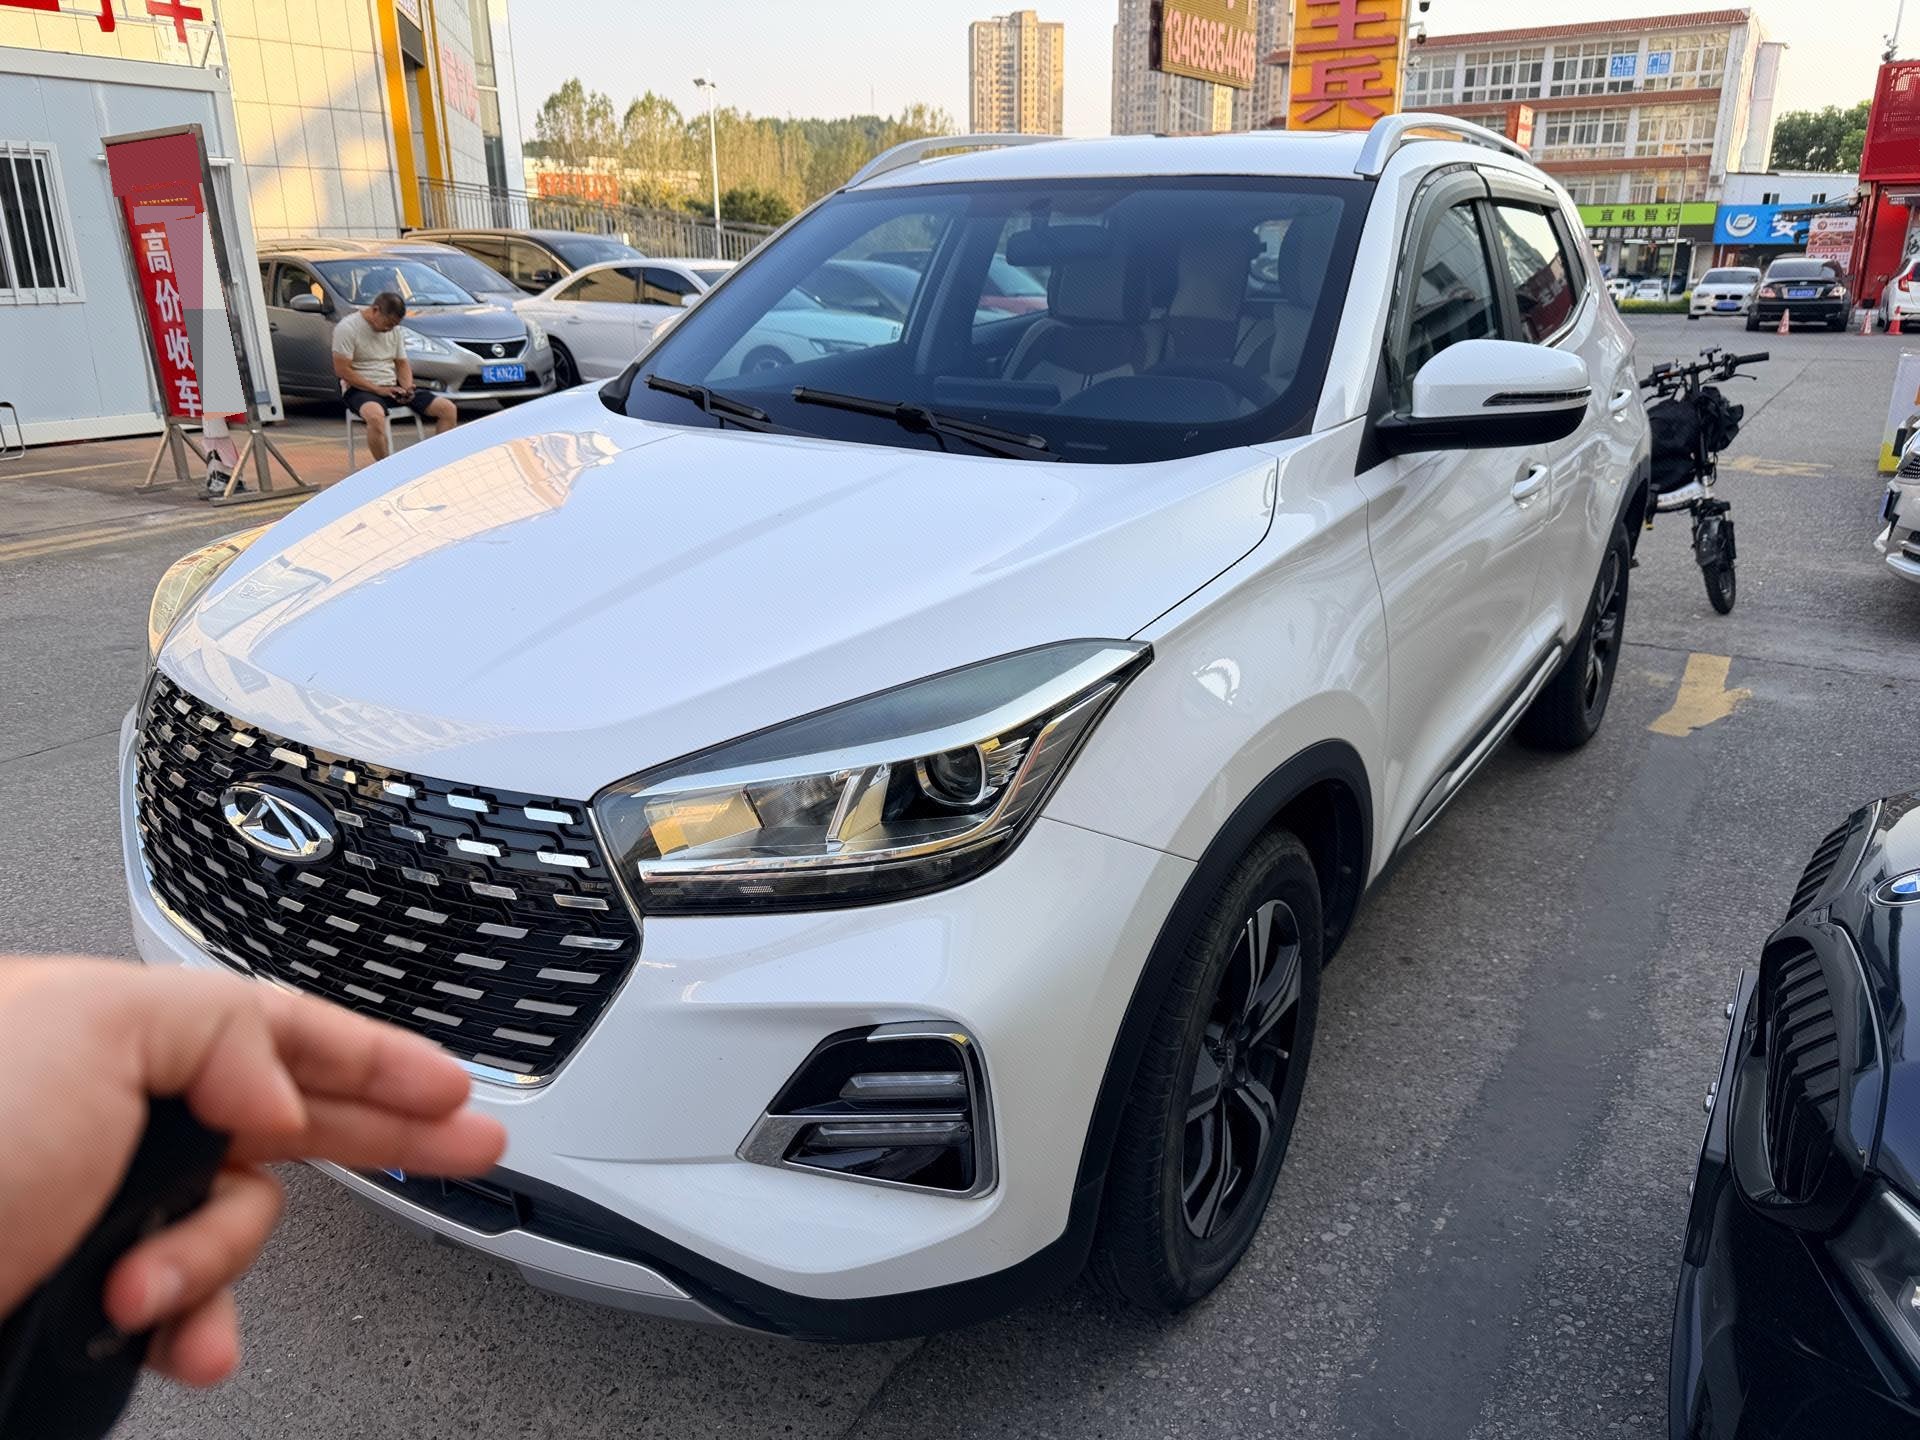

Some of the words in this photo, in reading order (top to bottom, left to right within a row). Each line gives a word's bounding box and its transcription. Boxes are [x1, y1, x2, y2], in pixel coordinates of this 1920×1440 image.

[1165, 8, 1257, 81] 13469854466
[141, 228, 202, 418] 高价收车
